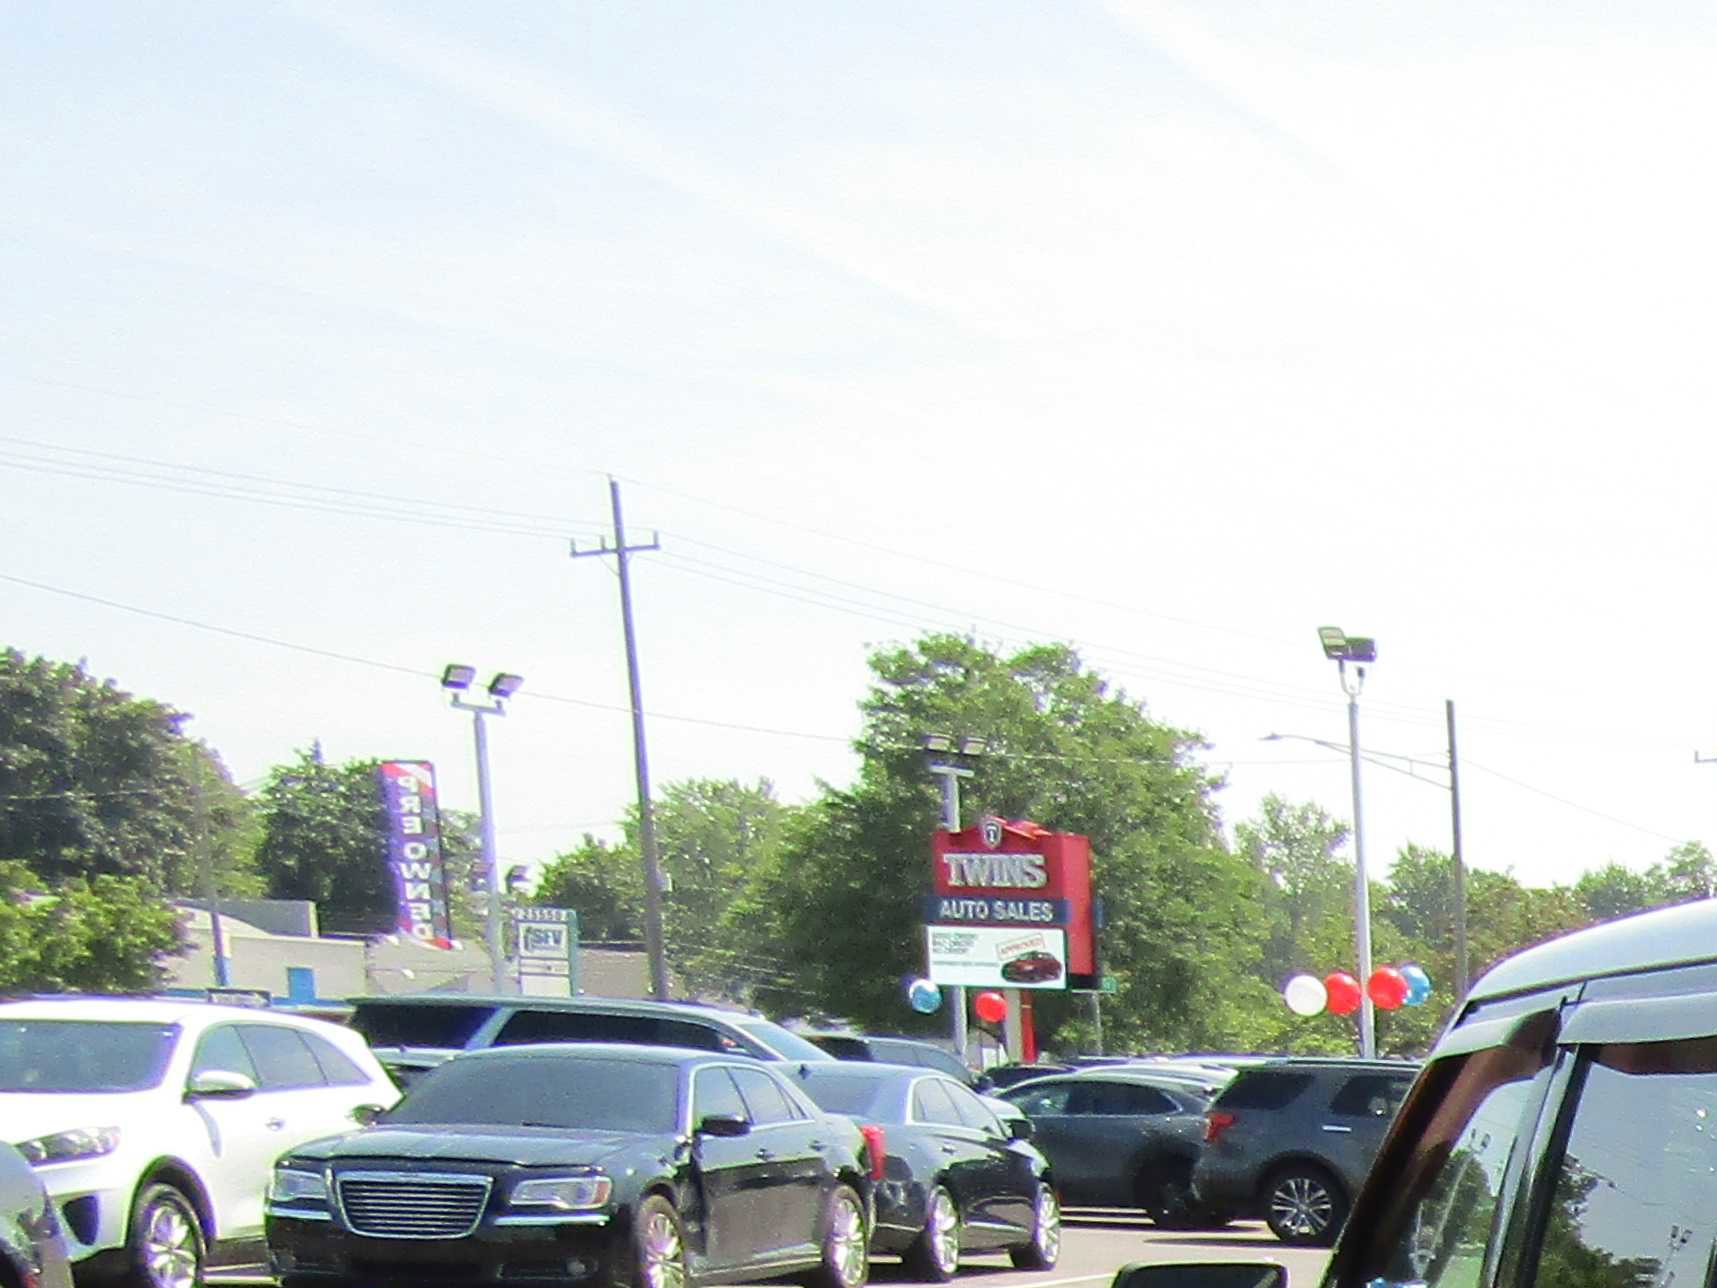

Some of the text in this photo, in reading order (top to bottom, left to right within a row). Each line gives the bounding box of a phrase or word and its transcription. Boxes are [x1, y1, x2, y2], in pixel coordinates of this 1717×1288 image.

[943, 853, 1048, 888] TWINS
[940, 900, 1053, 921] AUTO SALES
